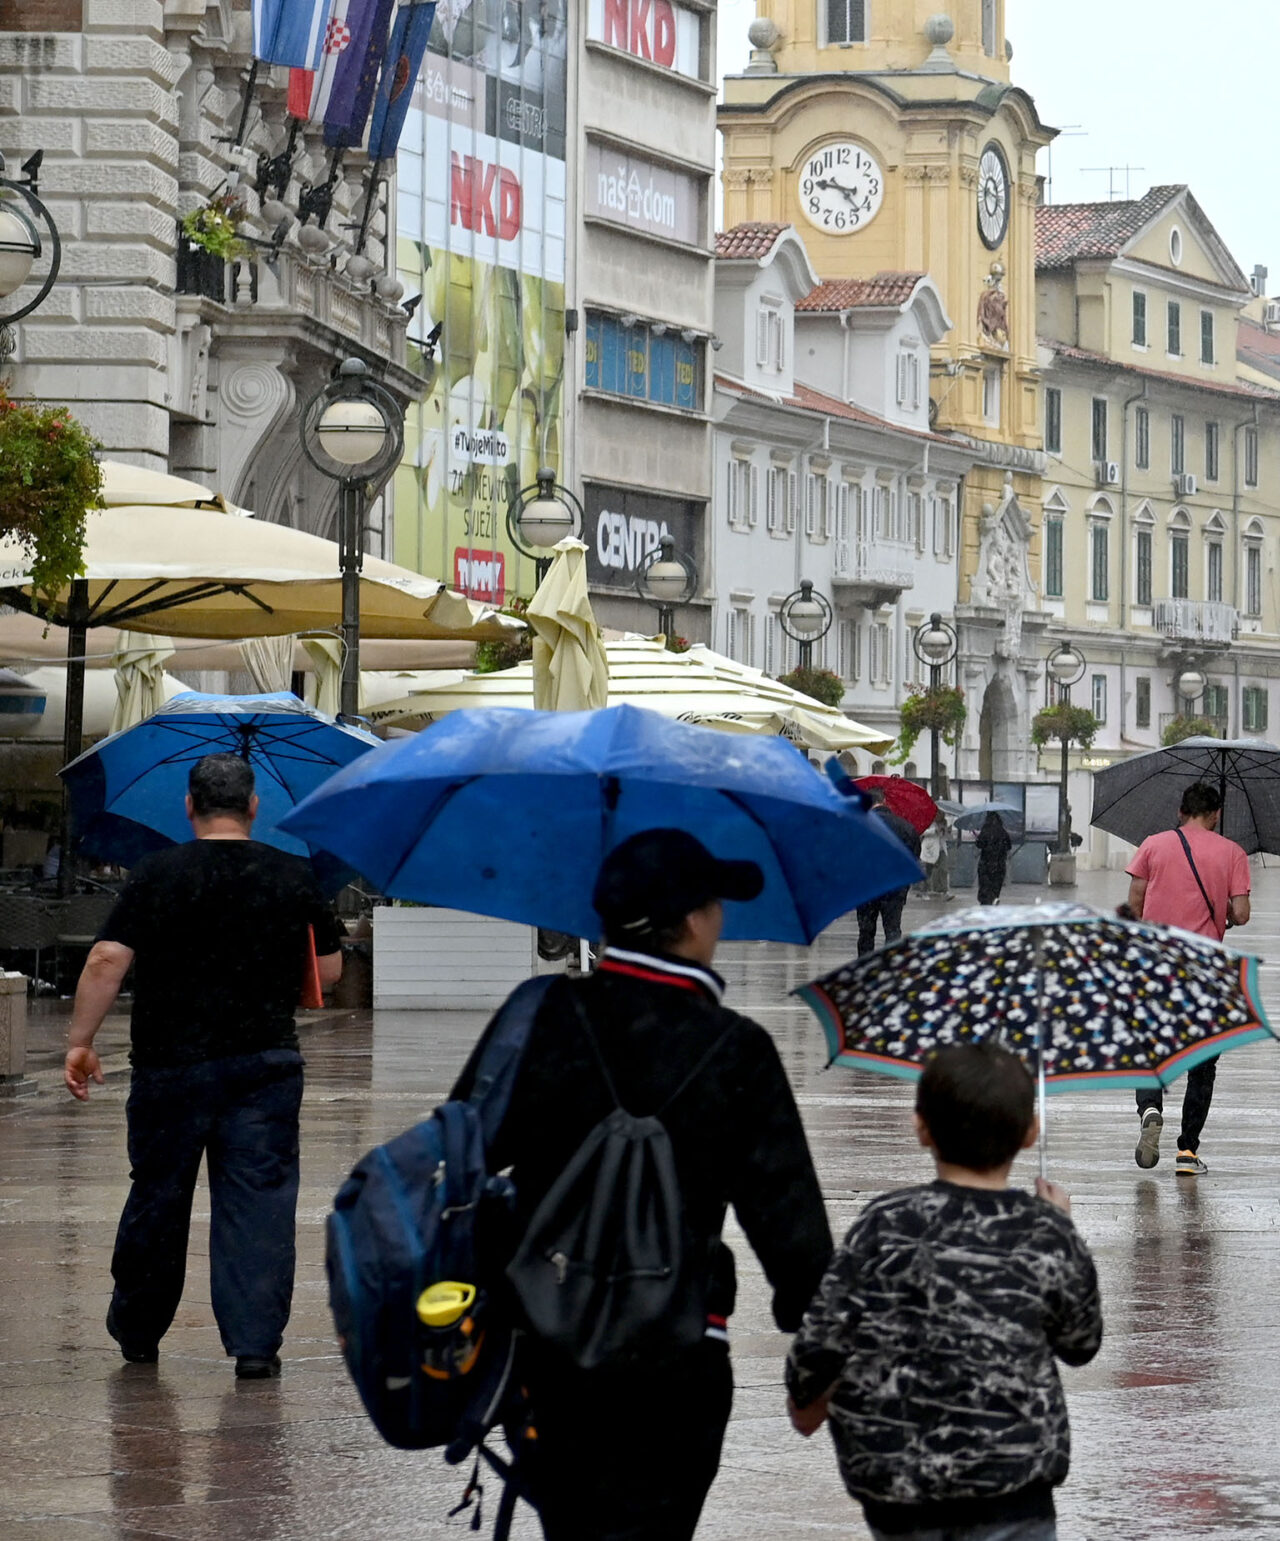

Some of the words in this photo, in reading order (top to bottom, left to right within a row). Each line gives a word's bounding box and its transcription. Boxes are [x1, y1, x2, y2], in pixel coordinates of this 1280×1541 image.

[603, 0, 676, 69] NKD
[823, 151, 833, 169] 11
[837, 148, 851, 165] 12
[856, 152, 861, 169] 1
[809, 160, 823, 177] 10
[863, 161, 872, 178] 2
[803, 178, 814, 196] 9
[868, 178, 879, 196] 3
[450, 150, 524, 242] NKD
[598, 166, 627, 212] naš
[642, 177, 675, 229] dom
[861, 195, 872, 212] 4
[809, 197, 820, 214] 8
[823, 208, 833, 225] 7
[835, 211, 846, 229] 6
